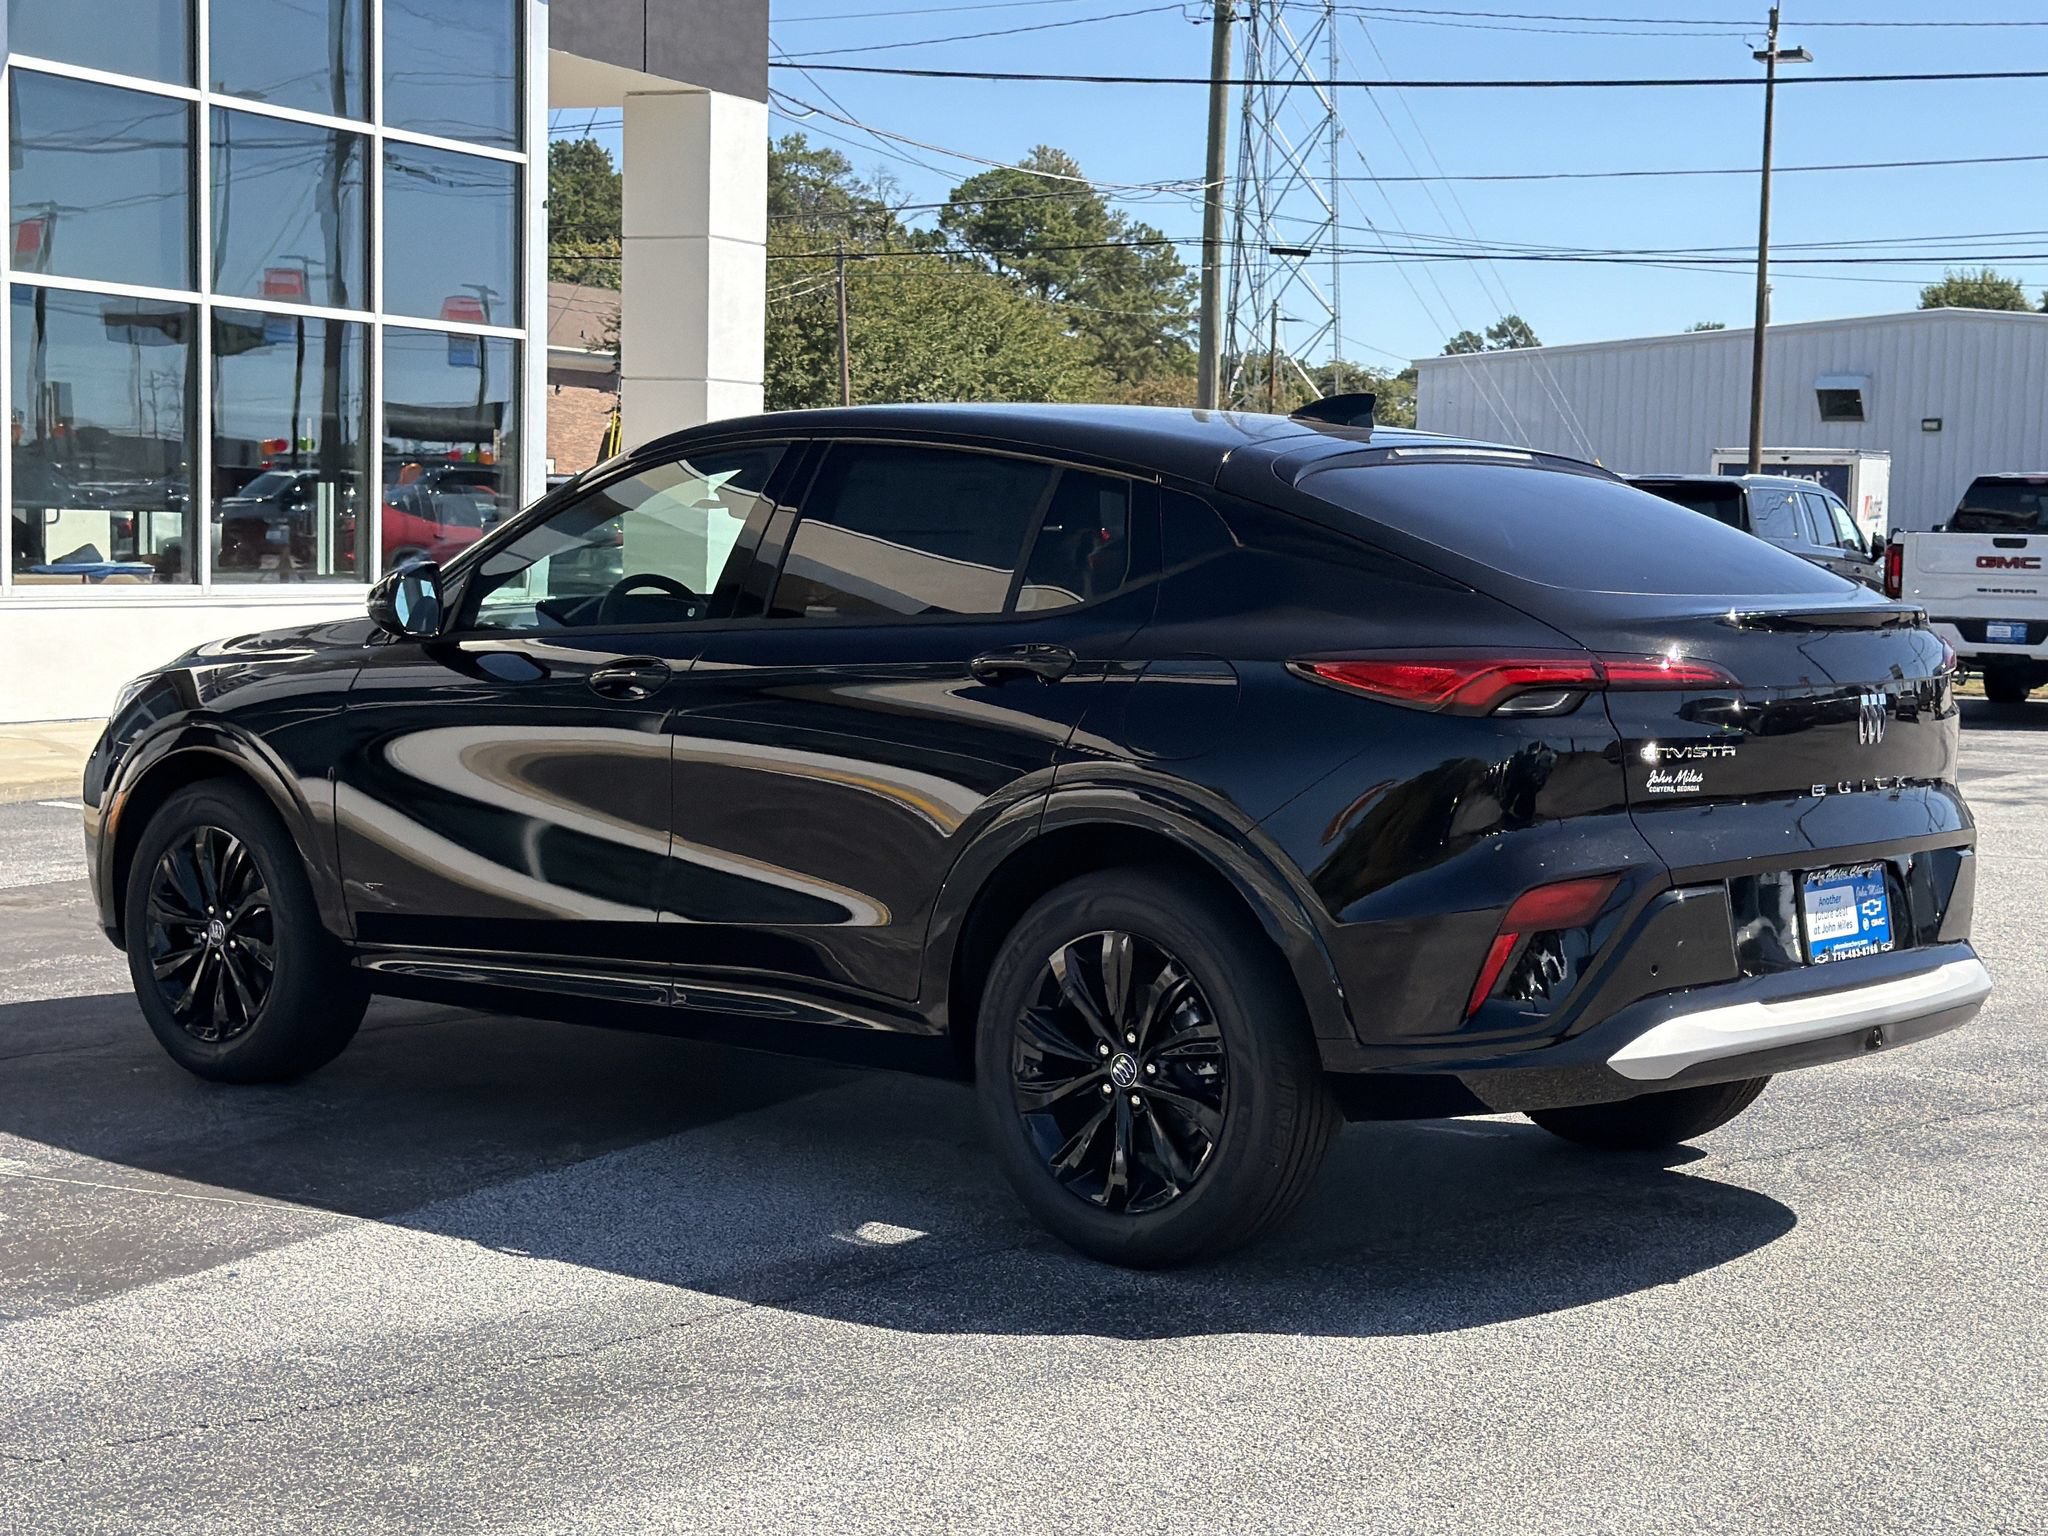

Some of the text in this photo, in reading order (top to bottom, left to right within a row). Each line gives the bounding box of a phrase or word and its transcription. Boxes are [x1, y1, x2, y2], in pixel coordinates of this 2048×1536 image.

[1976, 556, 2042, 569] GMC
[1646, 769, 1704, 787] John Miles
[1676, 785, 1700, 793] GEORGIA
[1811, 775, 1907, 797] BUICK
[1818, 894, 1841, 906] Another
[1835, 905, 1848, 917] deal
[1813, 919, 1853, 935] at John Miles
